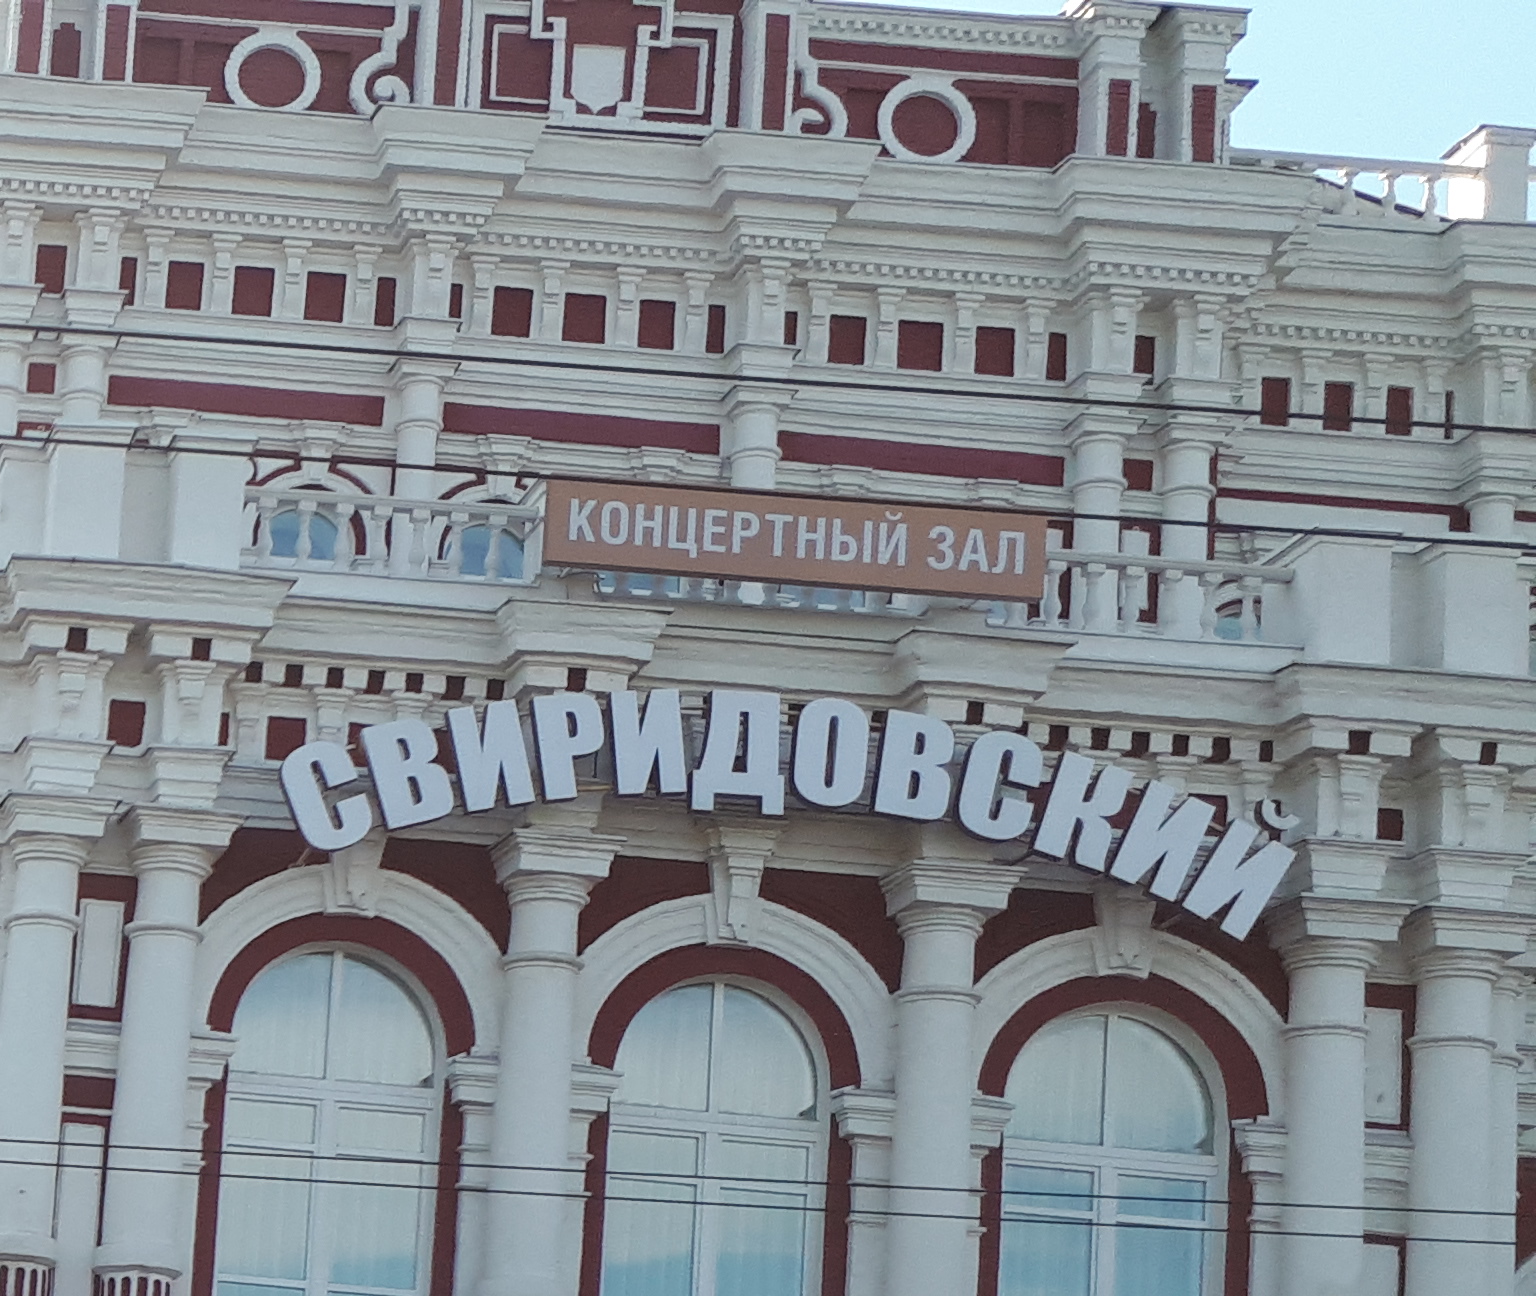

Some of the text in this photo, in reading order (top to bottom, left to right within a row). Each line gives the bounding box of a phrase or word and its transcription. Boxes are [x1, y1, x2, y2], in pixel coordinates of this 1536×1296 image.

[568, 498, 1026, 575] КОНЦЕРТНЫЙ ЗАЛ
[279, 688, 1303, 940] СВИРИДОВСКИЙ
